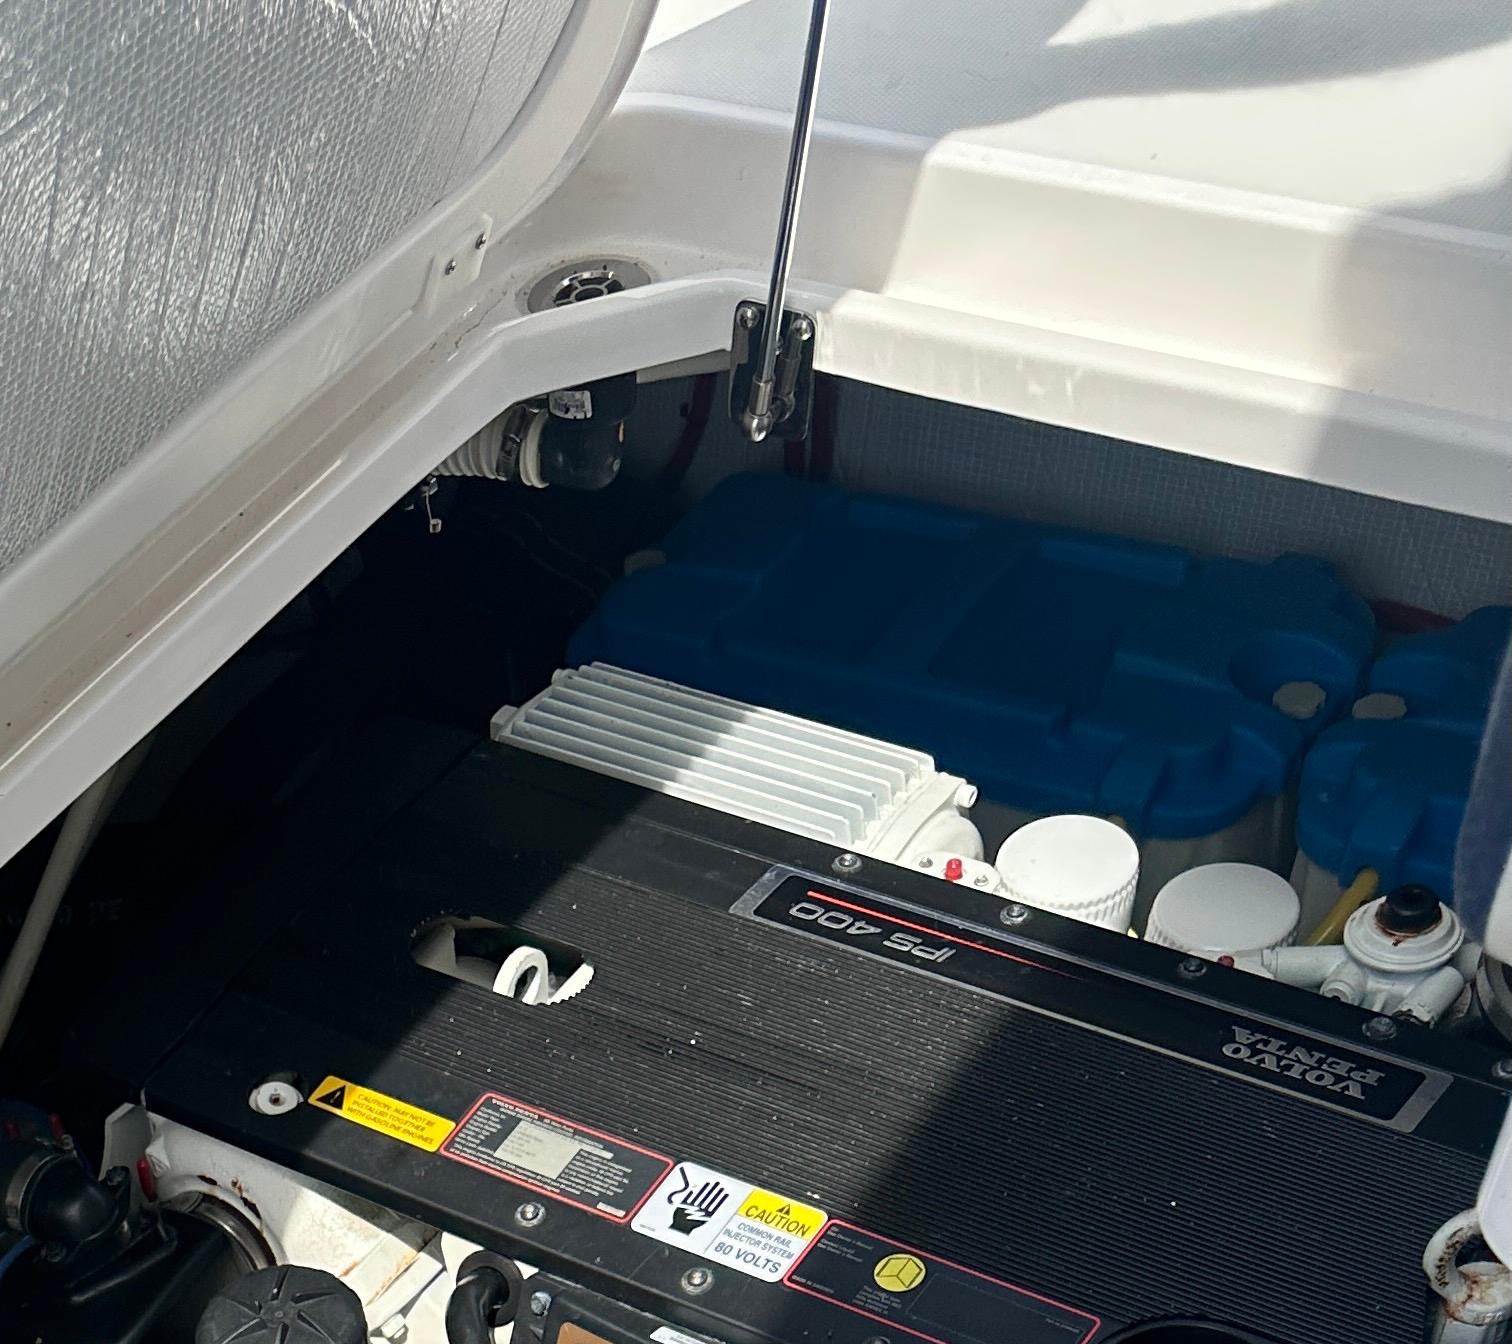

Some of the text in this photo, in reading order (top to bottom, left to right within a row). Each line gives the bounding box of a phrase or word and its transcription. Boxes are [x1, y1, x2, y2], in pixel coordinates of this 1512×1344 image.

[788, 902, 956, 963] IPS 400
[1222, 1042, 1366, 1100] VOLVO
[1232, 1025, 1386, 1086] PENTA
[346, 1106, 366, 1117] WITH
[364, 1114, 402, 1131] GASOLINE
[351, 1099, 425, 1132] INSTALLED TOGETHER
[409, 1113, 426, 1122] NOT
[736, 1221, 792, 1248] COMMON RAIL
[744, 1204, 810, 1237] CAUTION
[713, 1241, 781, 1273] 80 VOLTS
[722, 1228, 794, 1259] INJECTOR SYSTEM
